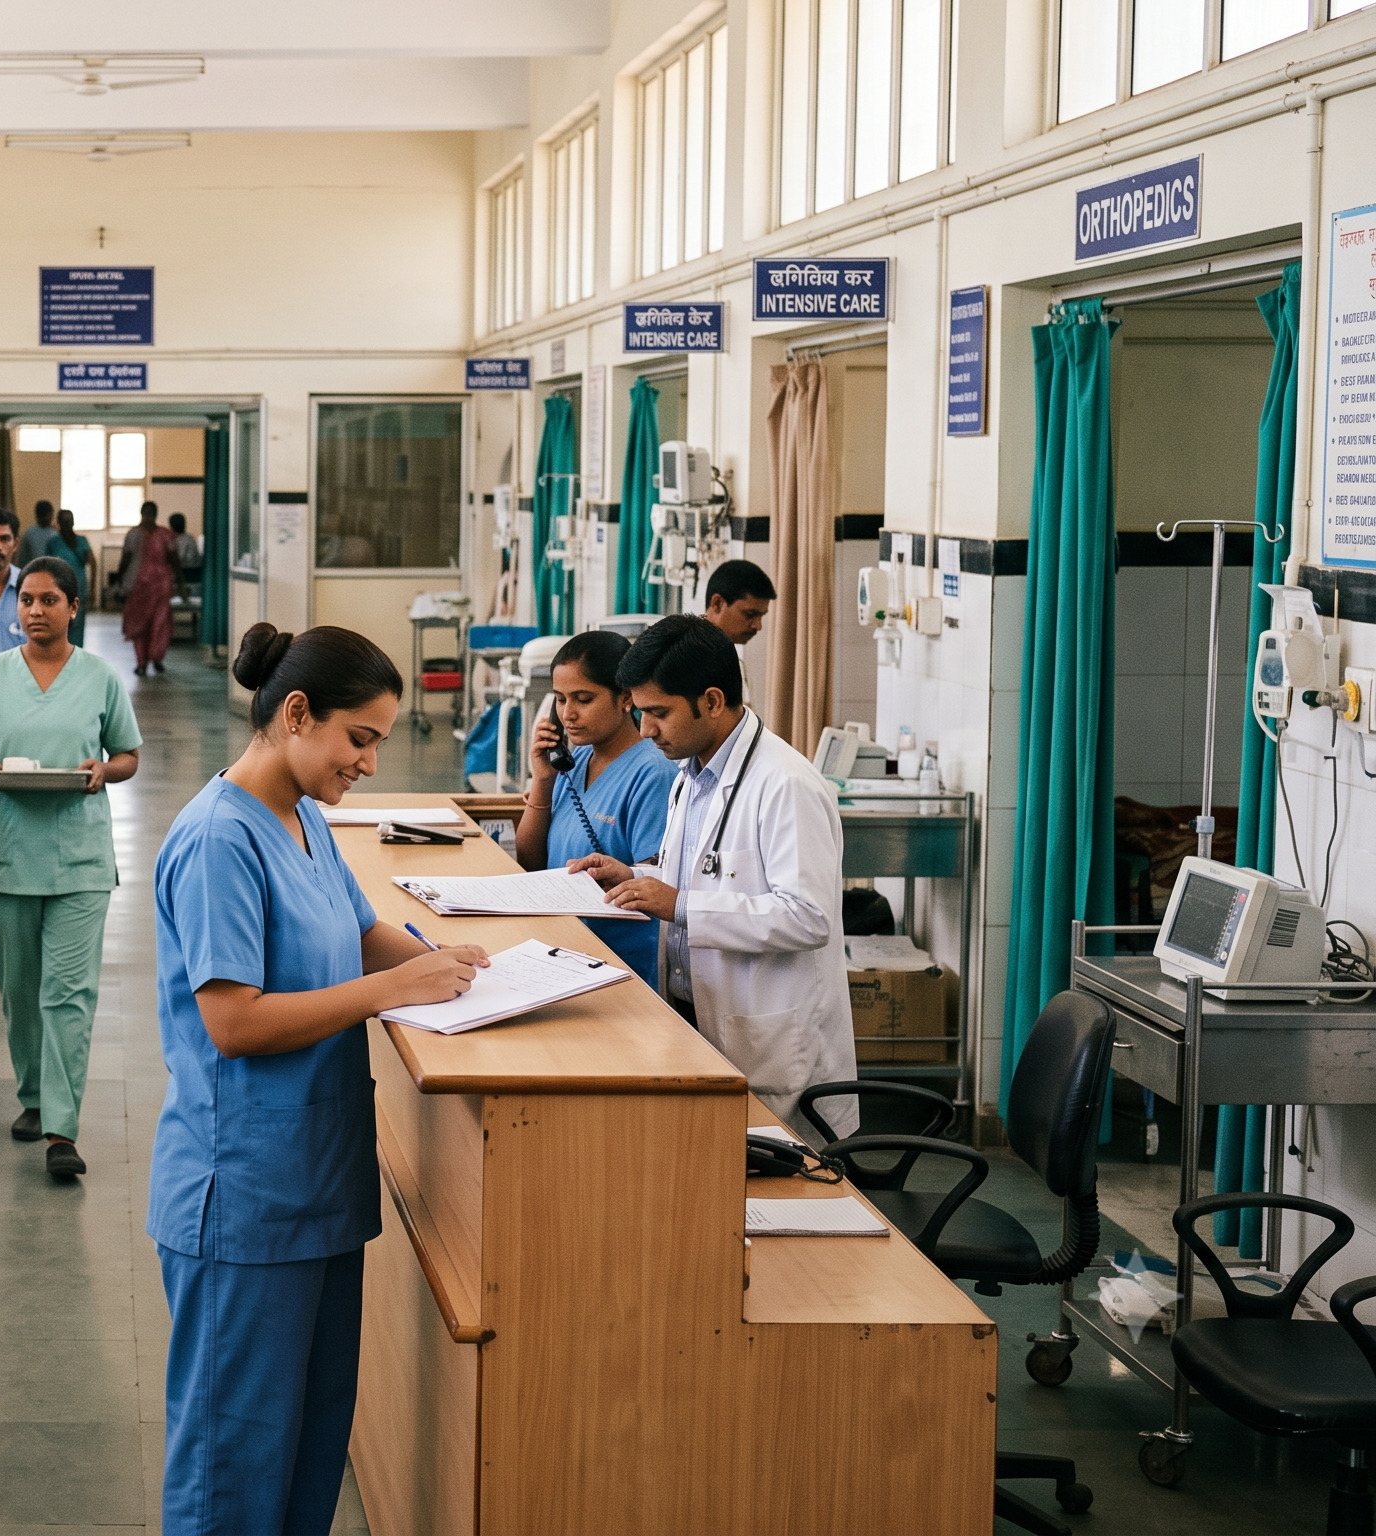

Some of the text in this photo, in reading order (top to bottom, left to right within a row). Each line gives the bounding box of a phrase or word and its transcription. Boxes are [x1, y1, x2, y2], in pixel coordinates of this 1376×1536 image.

[1079, 174, 1195, 245] ORTHOPEDICS
[761, 293, 880, 313] INTENSIVE CARE
[628, 331, 718, 348] INTENSIVE CARE
